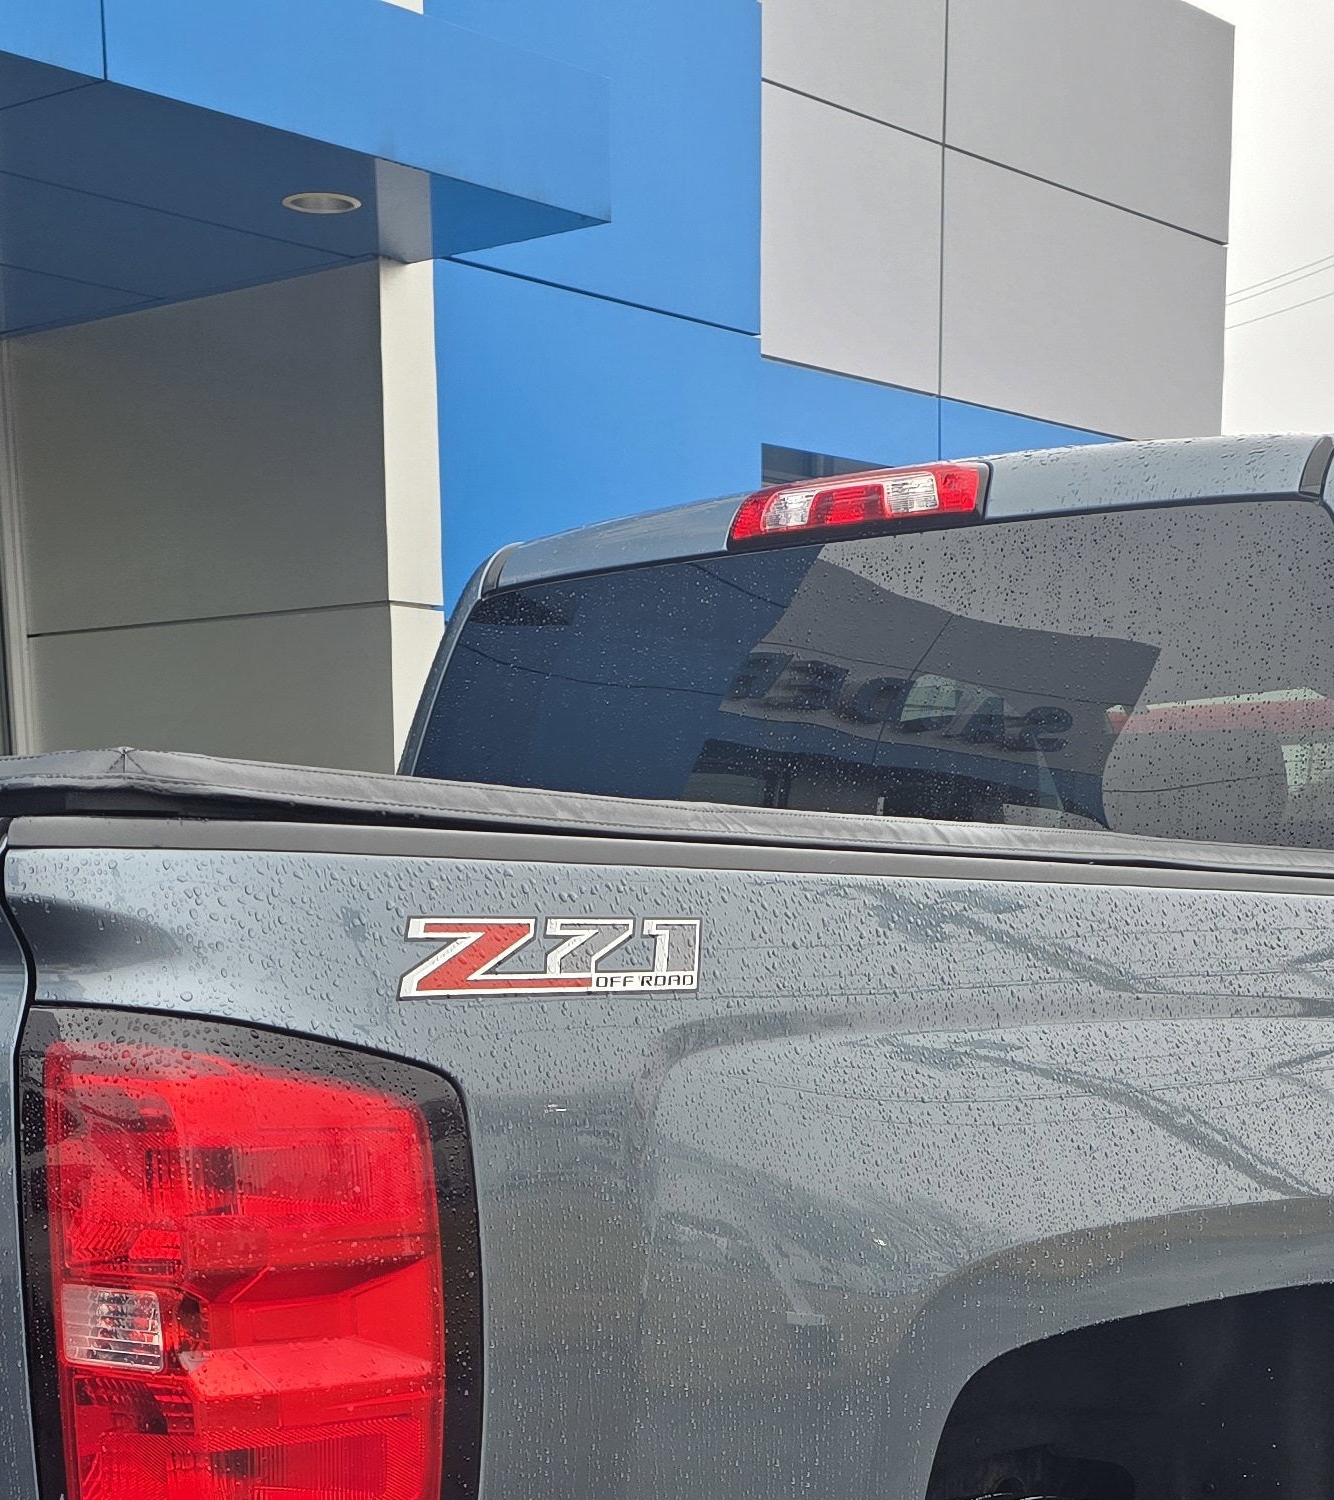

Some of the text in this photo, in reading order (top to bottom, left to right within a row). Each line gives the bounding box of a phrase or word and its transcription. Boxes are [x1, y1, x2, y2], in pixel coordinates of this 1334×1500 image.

[397, 916, 703, 1001] Z71
[595, 973, 694, 988] OFF ROAD
